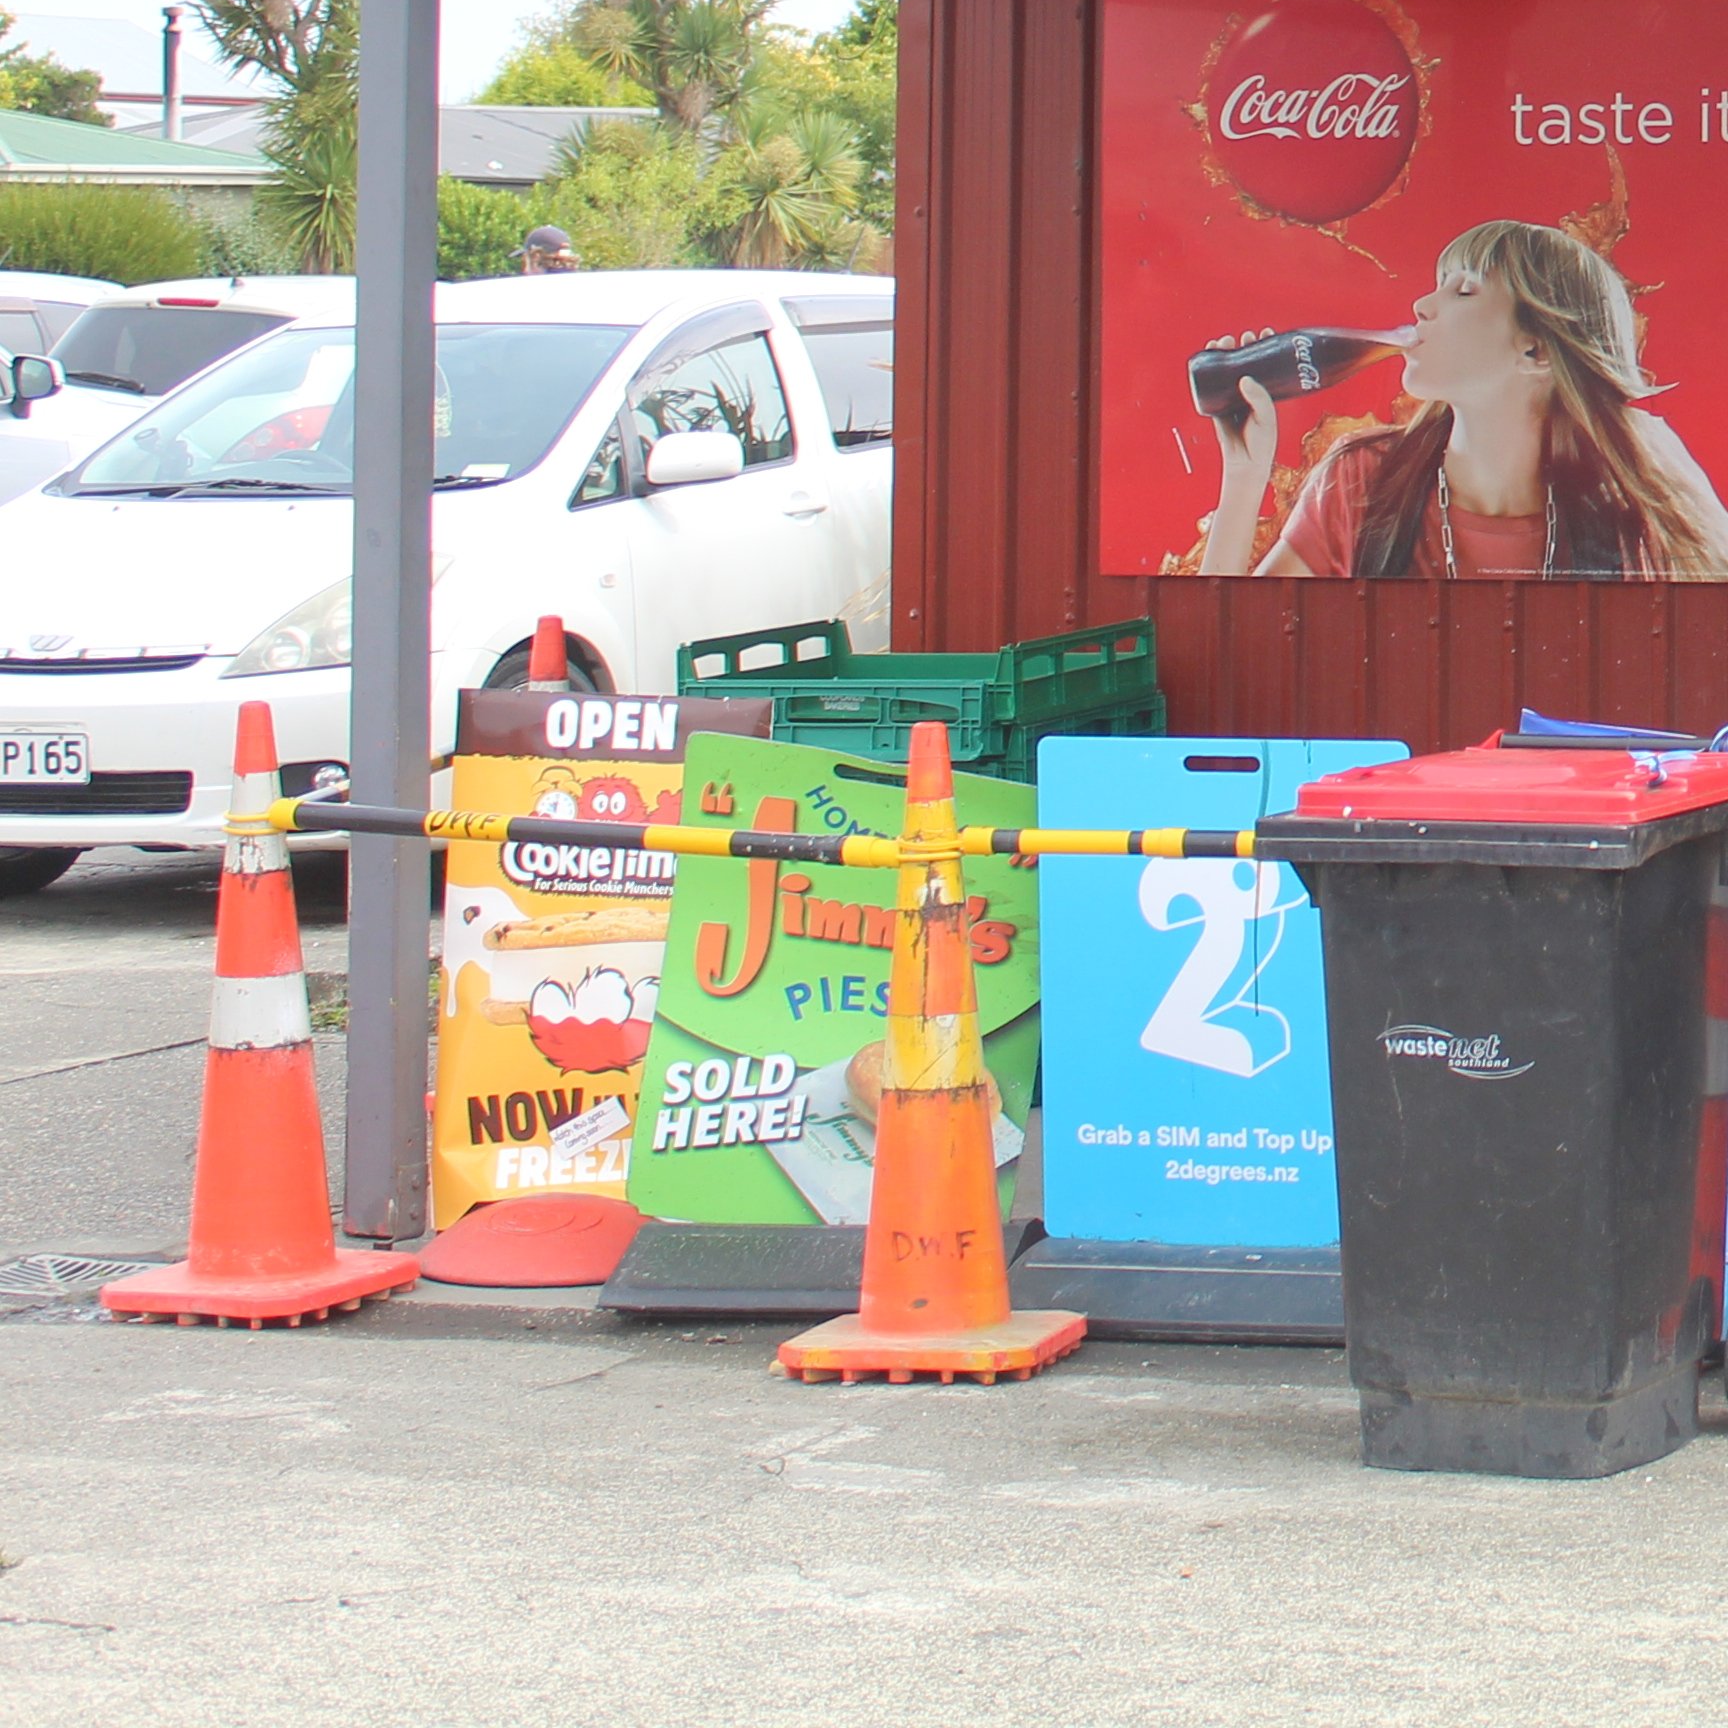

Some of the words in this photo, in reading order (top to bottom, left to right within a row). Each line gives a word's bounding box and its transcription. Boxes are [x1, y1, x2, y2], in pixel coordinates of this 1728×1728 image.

[1220, 72, 1412, 140] Coca-Cola
[1511, 92, 1674, 146] taste
[546, 698, 679, 750] OPEN
[3, 740, 83, 775] P165
[534, 880, 551, 891] For
[551, 880, 587, 894] Serious
[589, 881, 623, 895] Cookie
[625, 882, 675, 896] Munchers
[785, 975, 890, 1021] PIES
[662, 1053, 798, 1107] SOLD
[1447, 1057, 1510, 1068] southland
[468, 1087, 584, 1146] NOW
[653, 1093, 811, 1153] HERE!
[1077, 1123, 1133, 1146] Grab
[1138, 1130, 1151, 1147] a
[1156, 1125, 1200, 1148] SIM
[1207, 1128, 1247, 1149] and
[1253, 1128, 1295, 1154] Top
[1300, 1129, 1332, 1155] Up
[1165, 1159, 1299, 1185] 2degrees.nz
